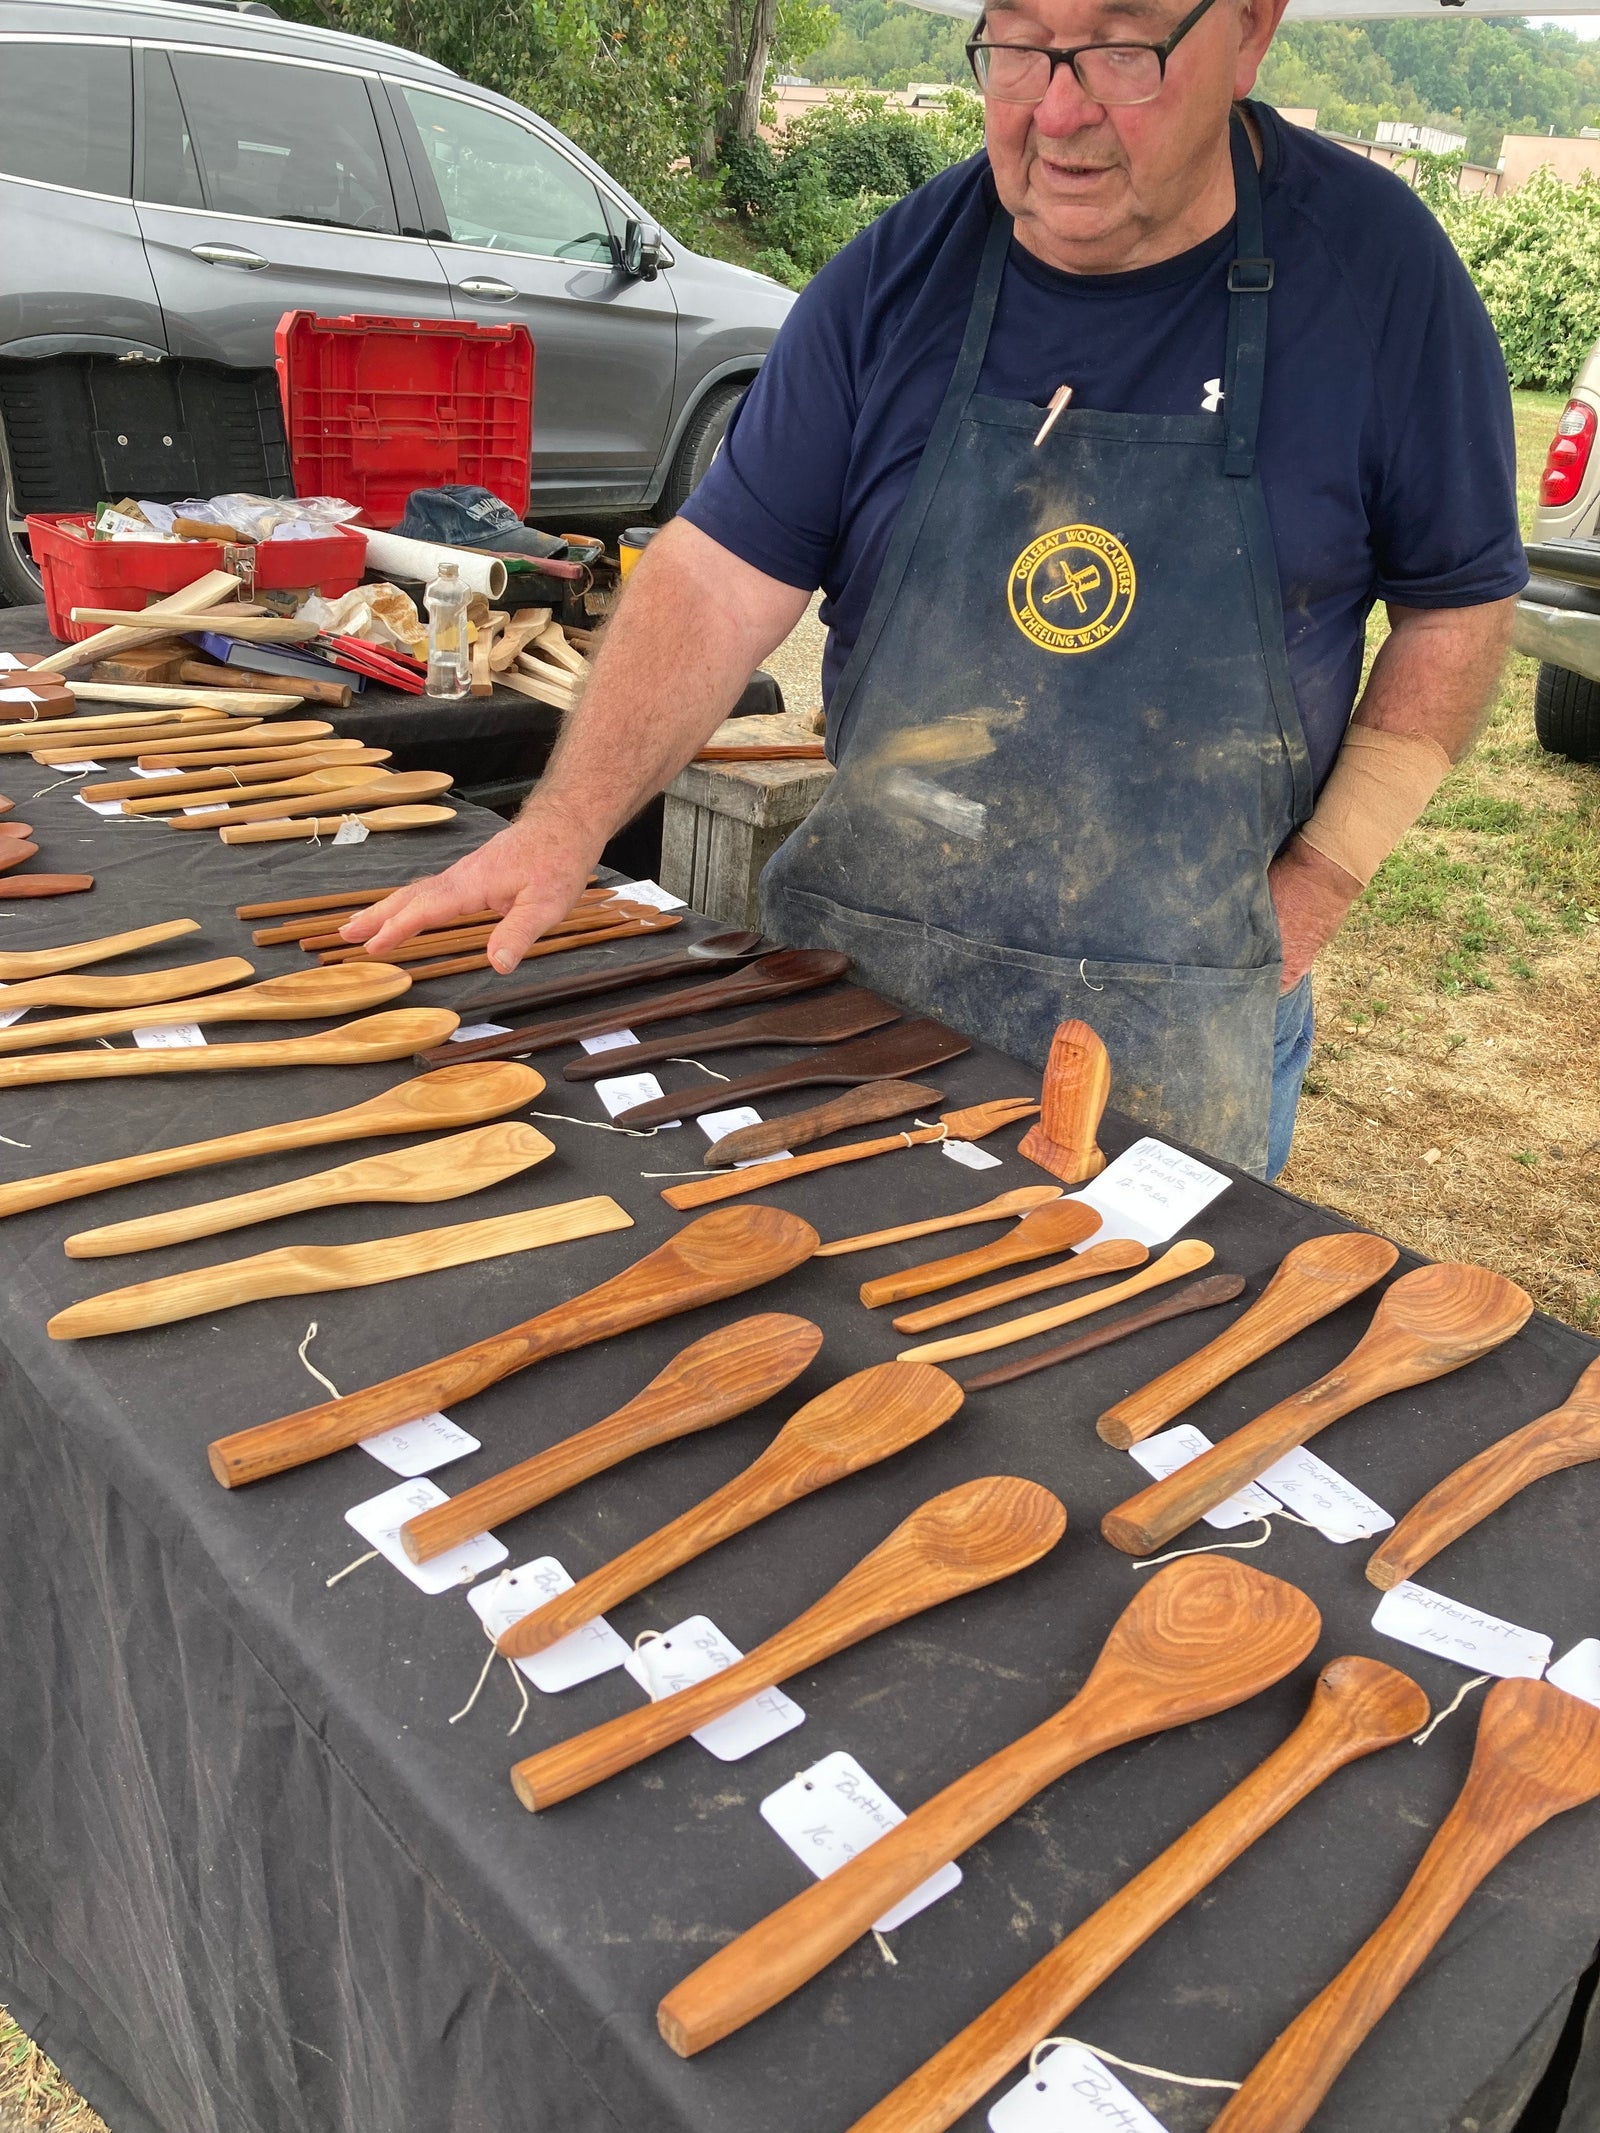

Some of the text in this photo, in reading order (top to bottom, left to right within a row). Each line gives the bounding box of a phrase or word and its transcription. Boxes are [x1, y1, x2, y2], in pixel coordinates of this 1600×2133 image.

[1017, 530, 1131, 595] OGLEBAY WOODCARVERS
[1018, 605, 1078, 648] WHEELING,
